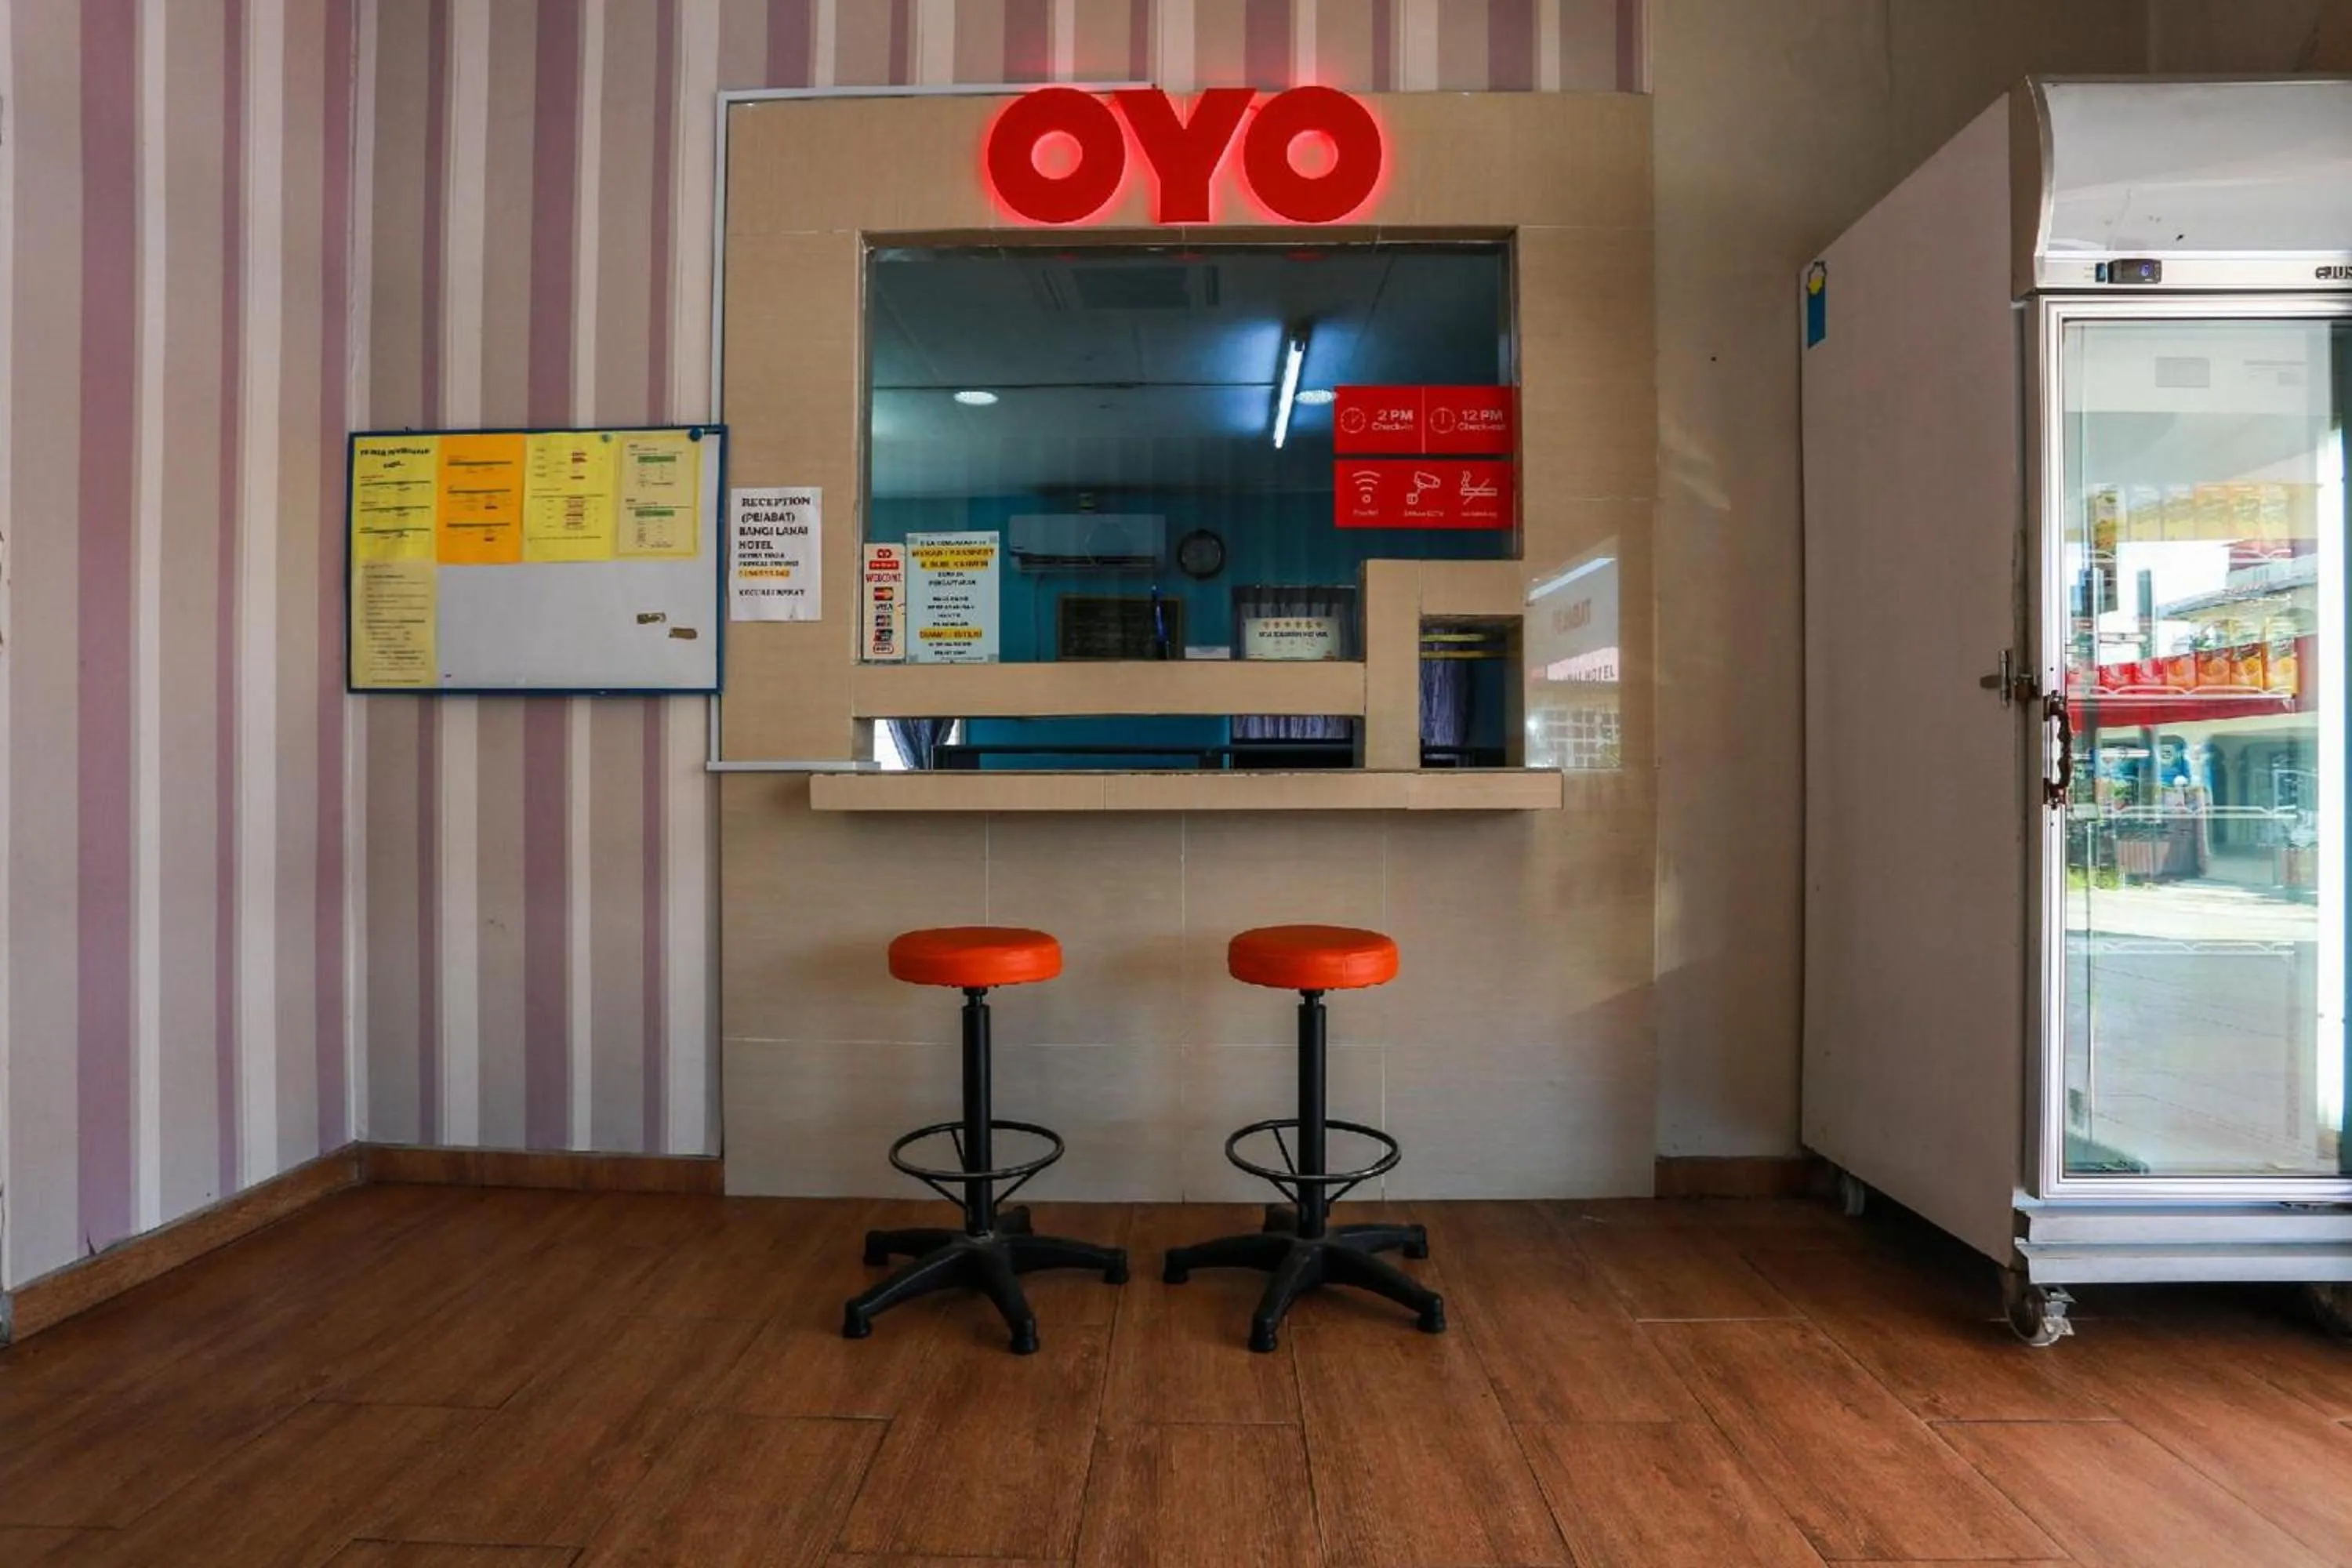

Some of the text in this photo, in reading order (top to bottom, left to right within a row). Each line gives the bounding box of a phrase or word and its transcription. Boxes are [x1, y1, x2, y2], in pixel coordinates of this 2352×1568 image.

[987, 86, 1382, 224] OYO
[1377, 409, 1414, 421] 2 PM
[1461, 409, 1504, 421] 12 PM
[741, 496, 811, 507] RECEPTION
[738, 540, 774, 550] HOTEL
